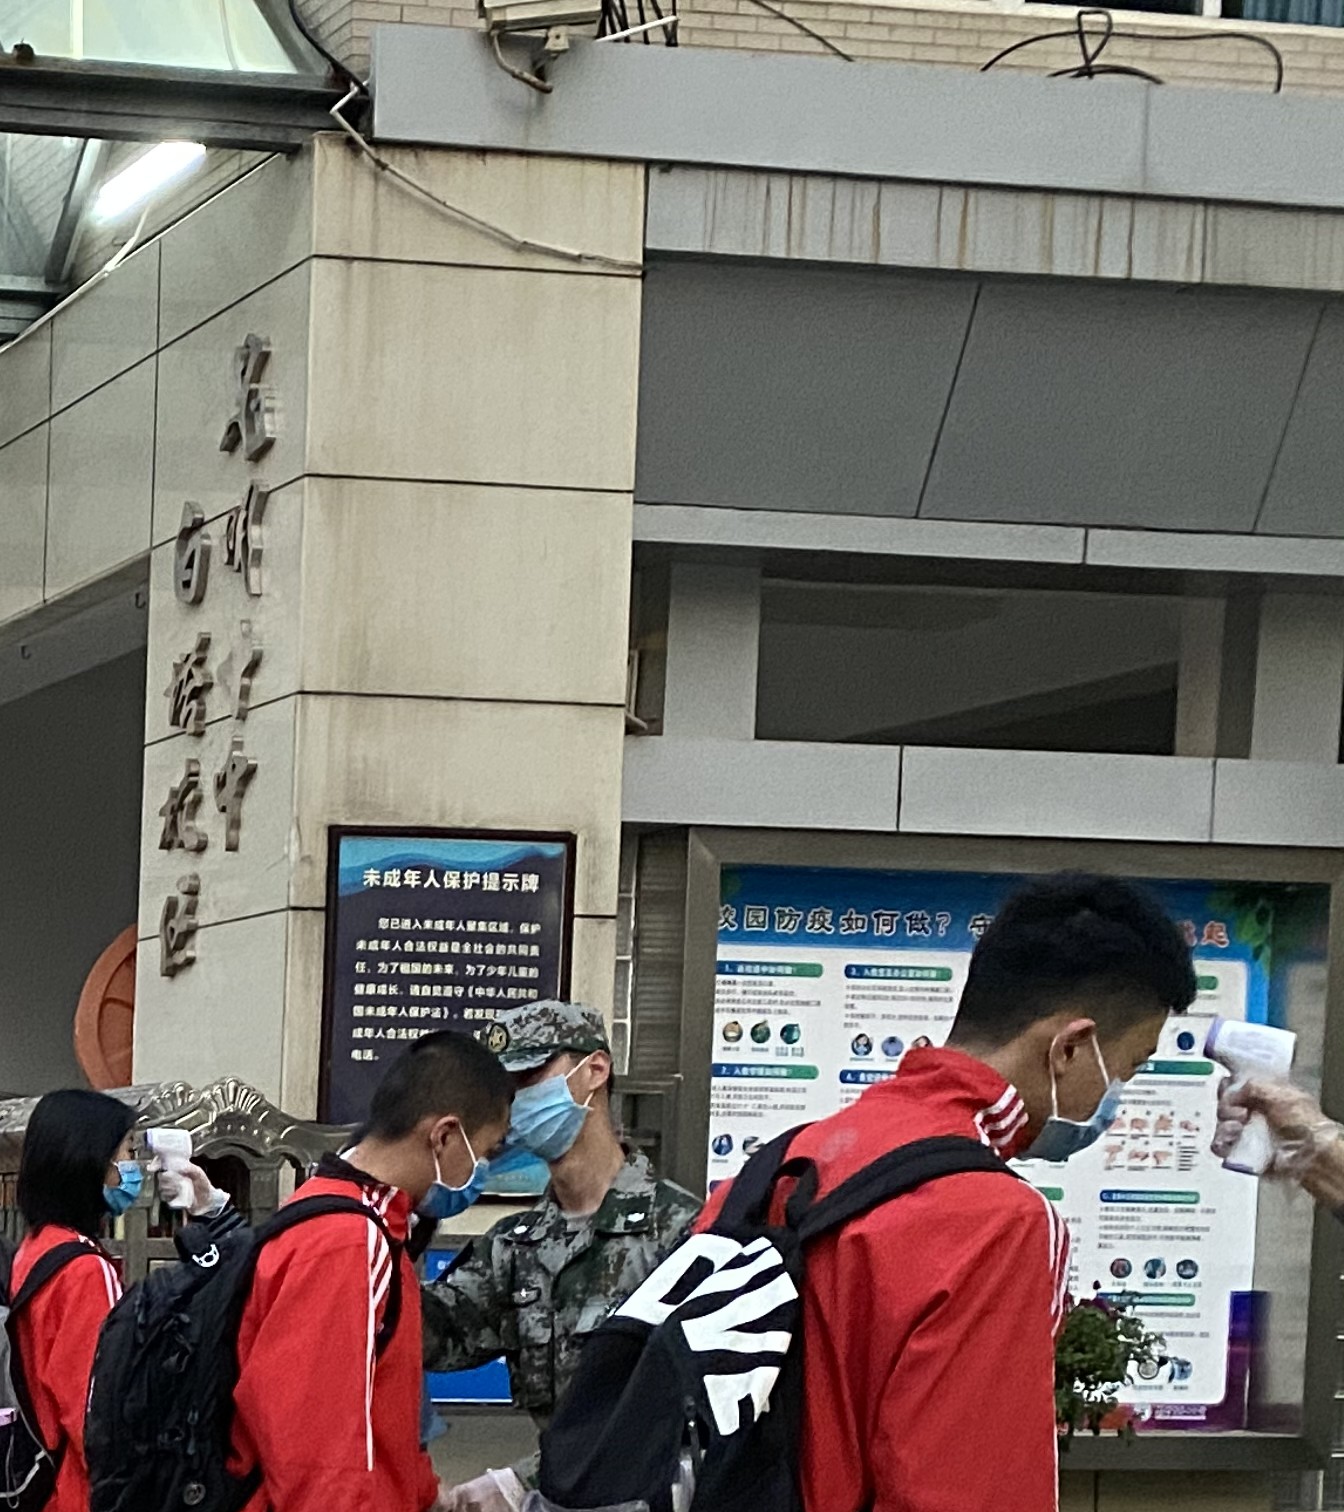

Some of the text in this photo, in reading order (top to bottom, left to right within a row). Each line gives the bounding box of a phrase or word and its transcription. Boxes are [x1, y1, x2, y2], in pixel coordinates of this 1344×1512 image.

[363, 868, 540, 893] 未成年人保护提示牌
